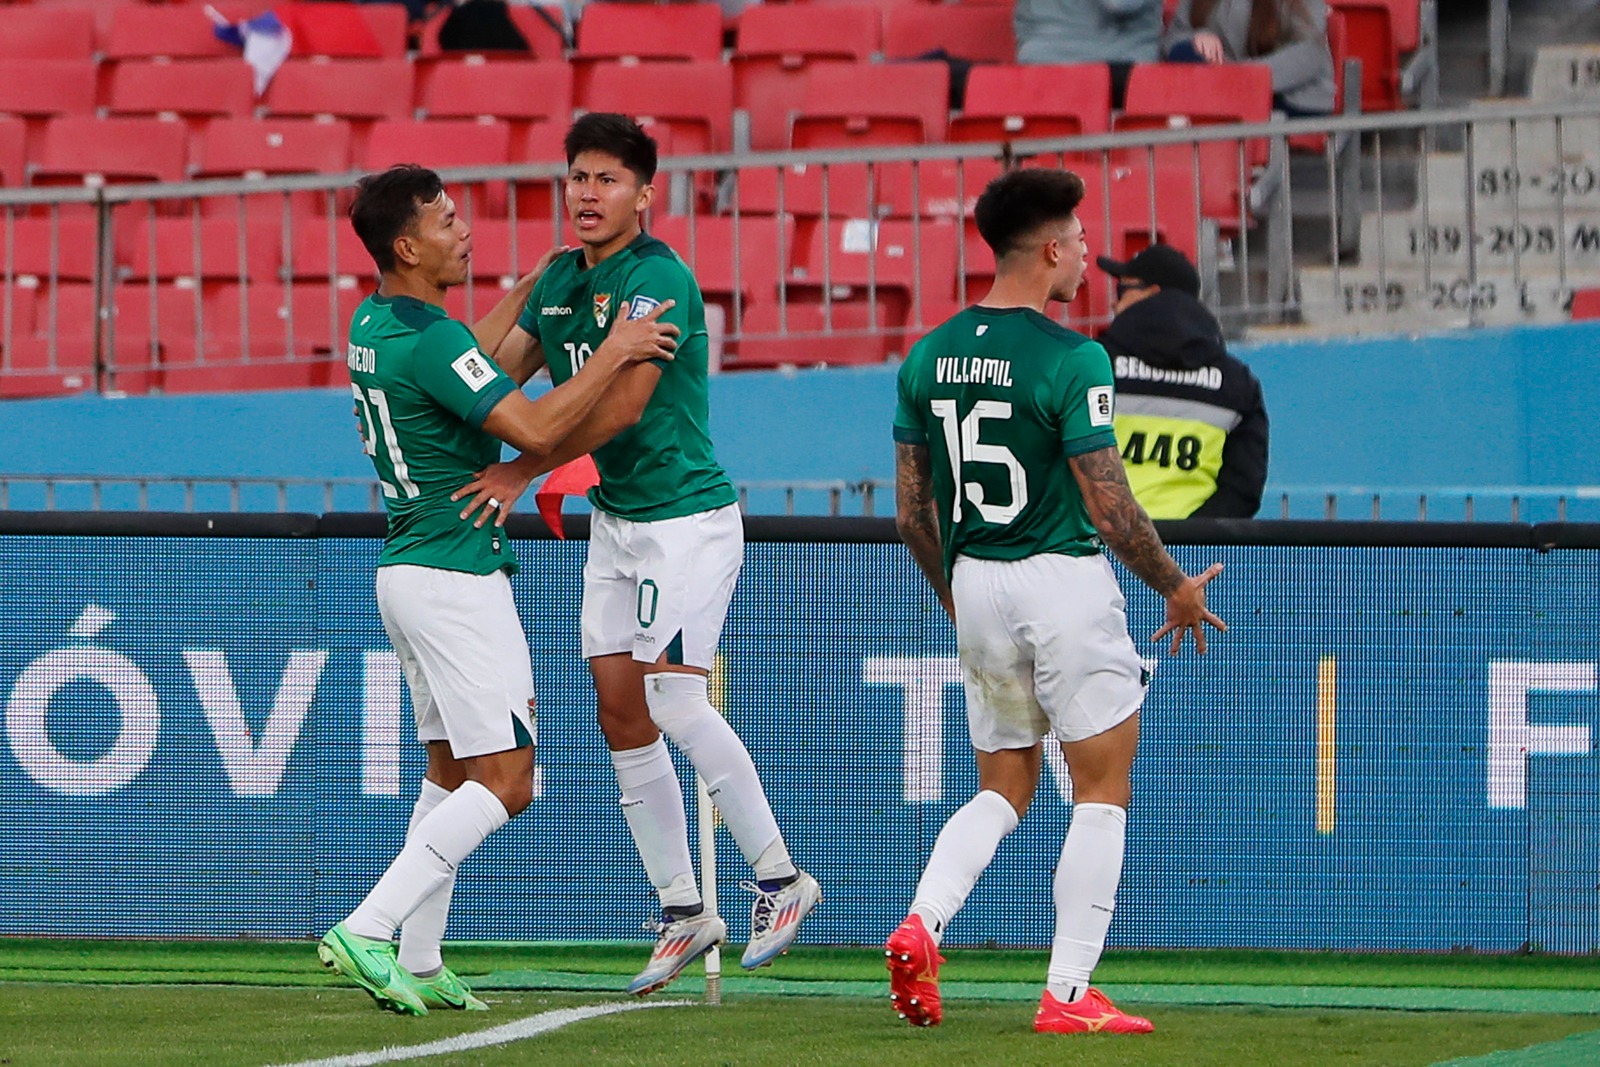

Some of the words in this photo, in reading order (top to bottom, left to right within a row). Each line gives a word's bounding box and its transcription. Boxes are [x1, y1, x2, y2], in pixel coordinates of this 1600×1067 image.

[935, 357, 1013, 387] VILLAMIL
[930, 399, 1028, 525] 15
[1121, 431, 1203, 471] 448
[1487, 657, 1598, 810] F
